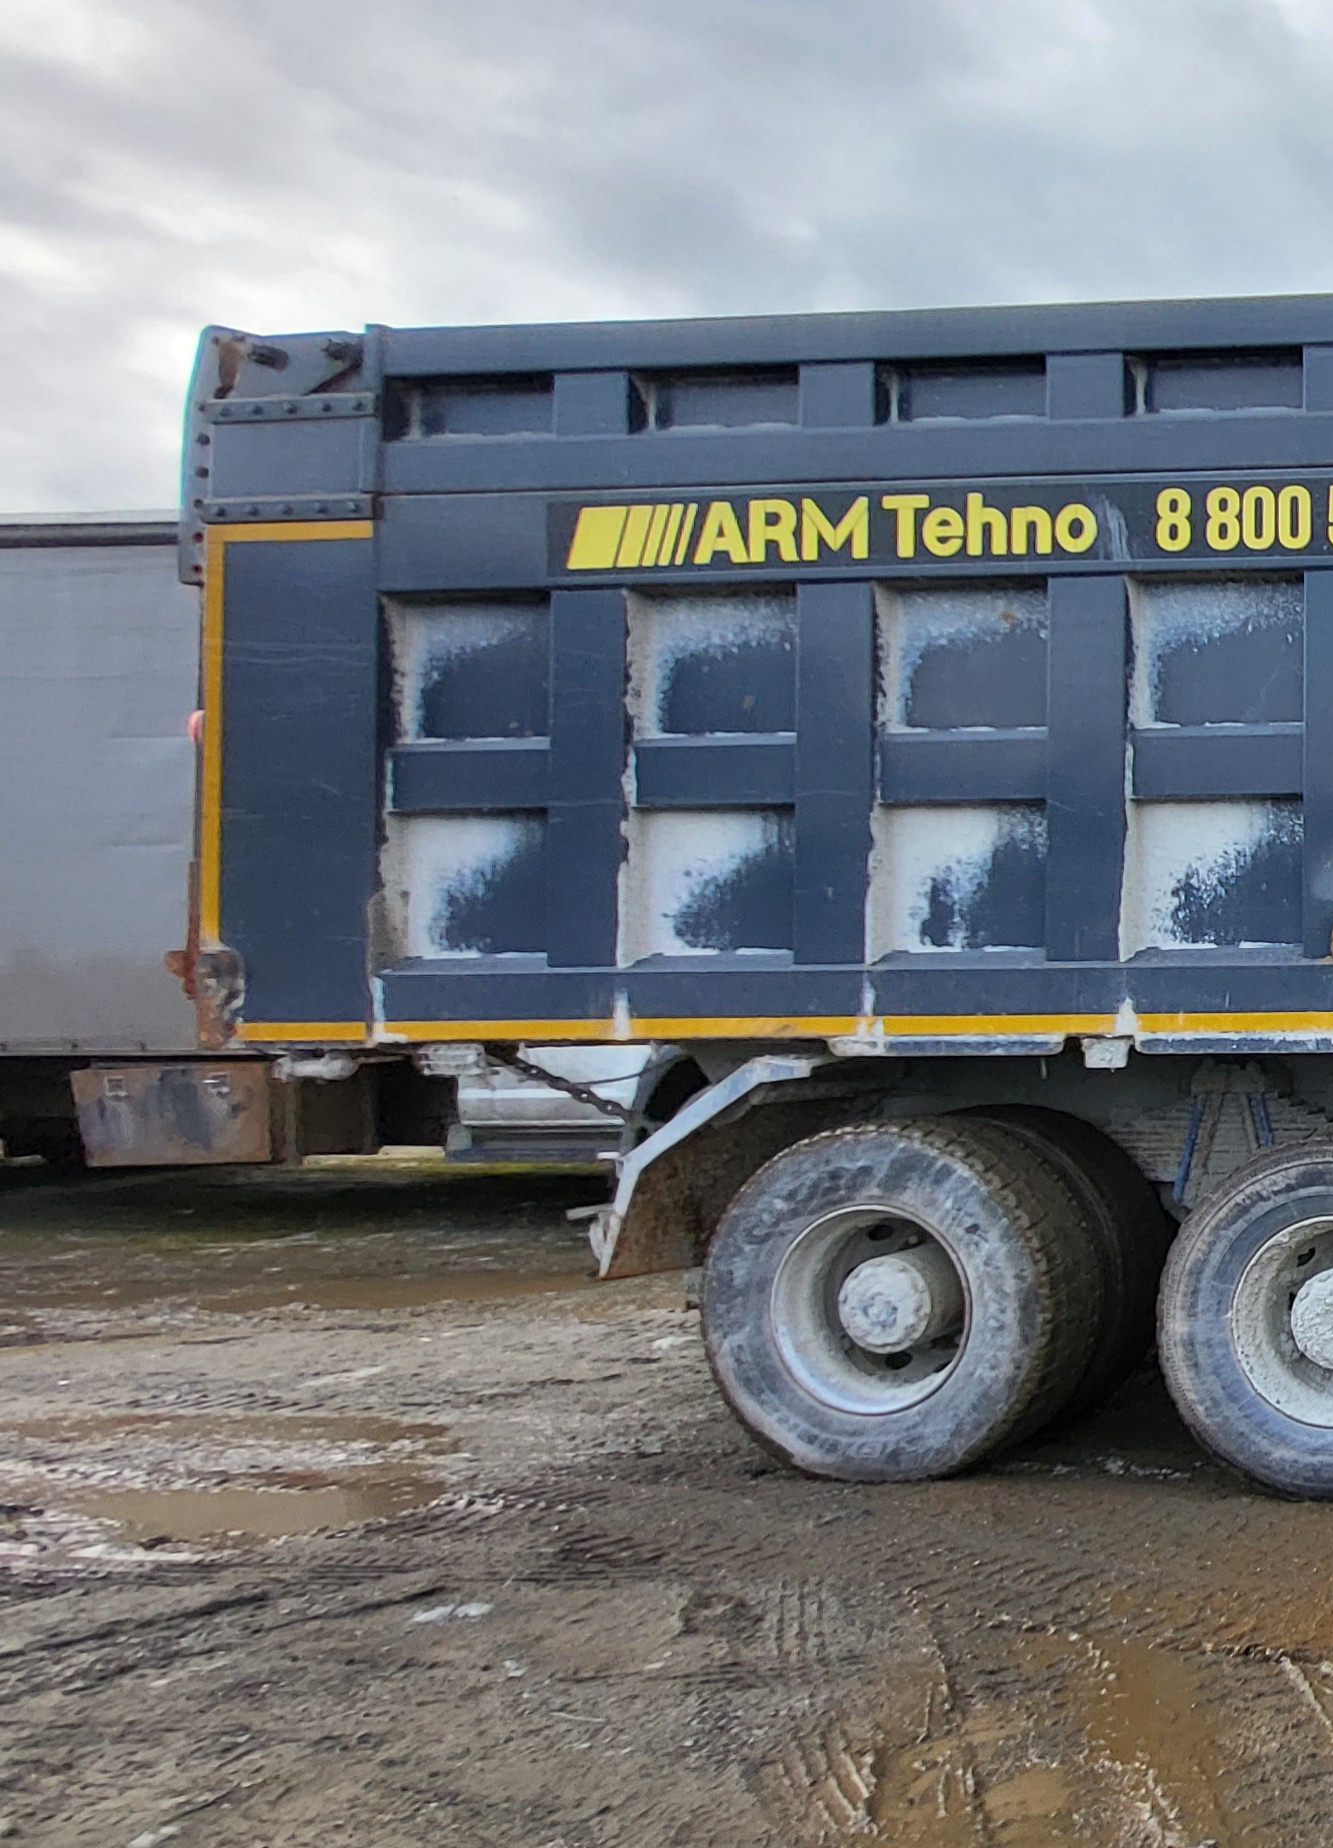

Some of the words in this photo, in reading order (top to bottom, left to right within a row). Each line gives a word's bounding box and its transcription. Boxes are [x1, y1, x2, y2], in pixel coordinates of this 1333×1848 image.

[693, 496, 869, 564] ARM
[882, 492, 1098, 558] Tehno
[1155, 487, 1192, 552] 8
[1205, 484, 1313, 551] 800
